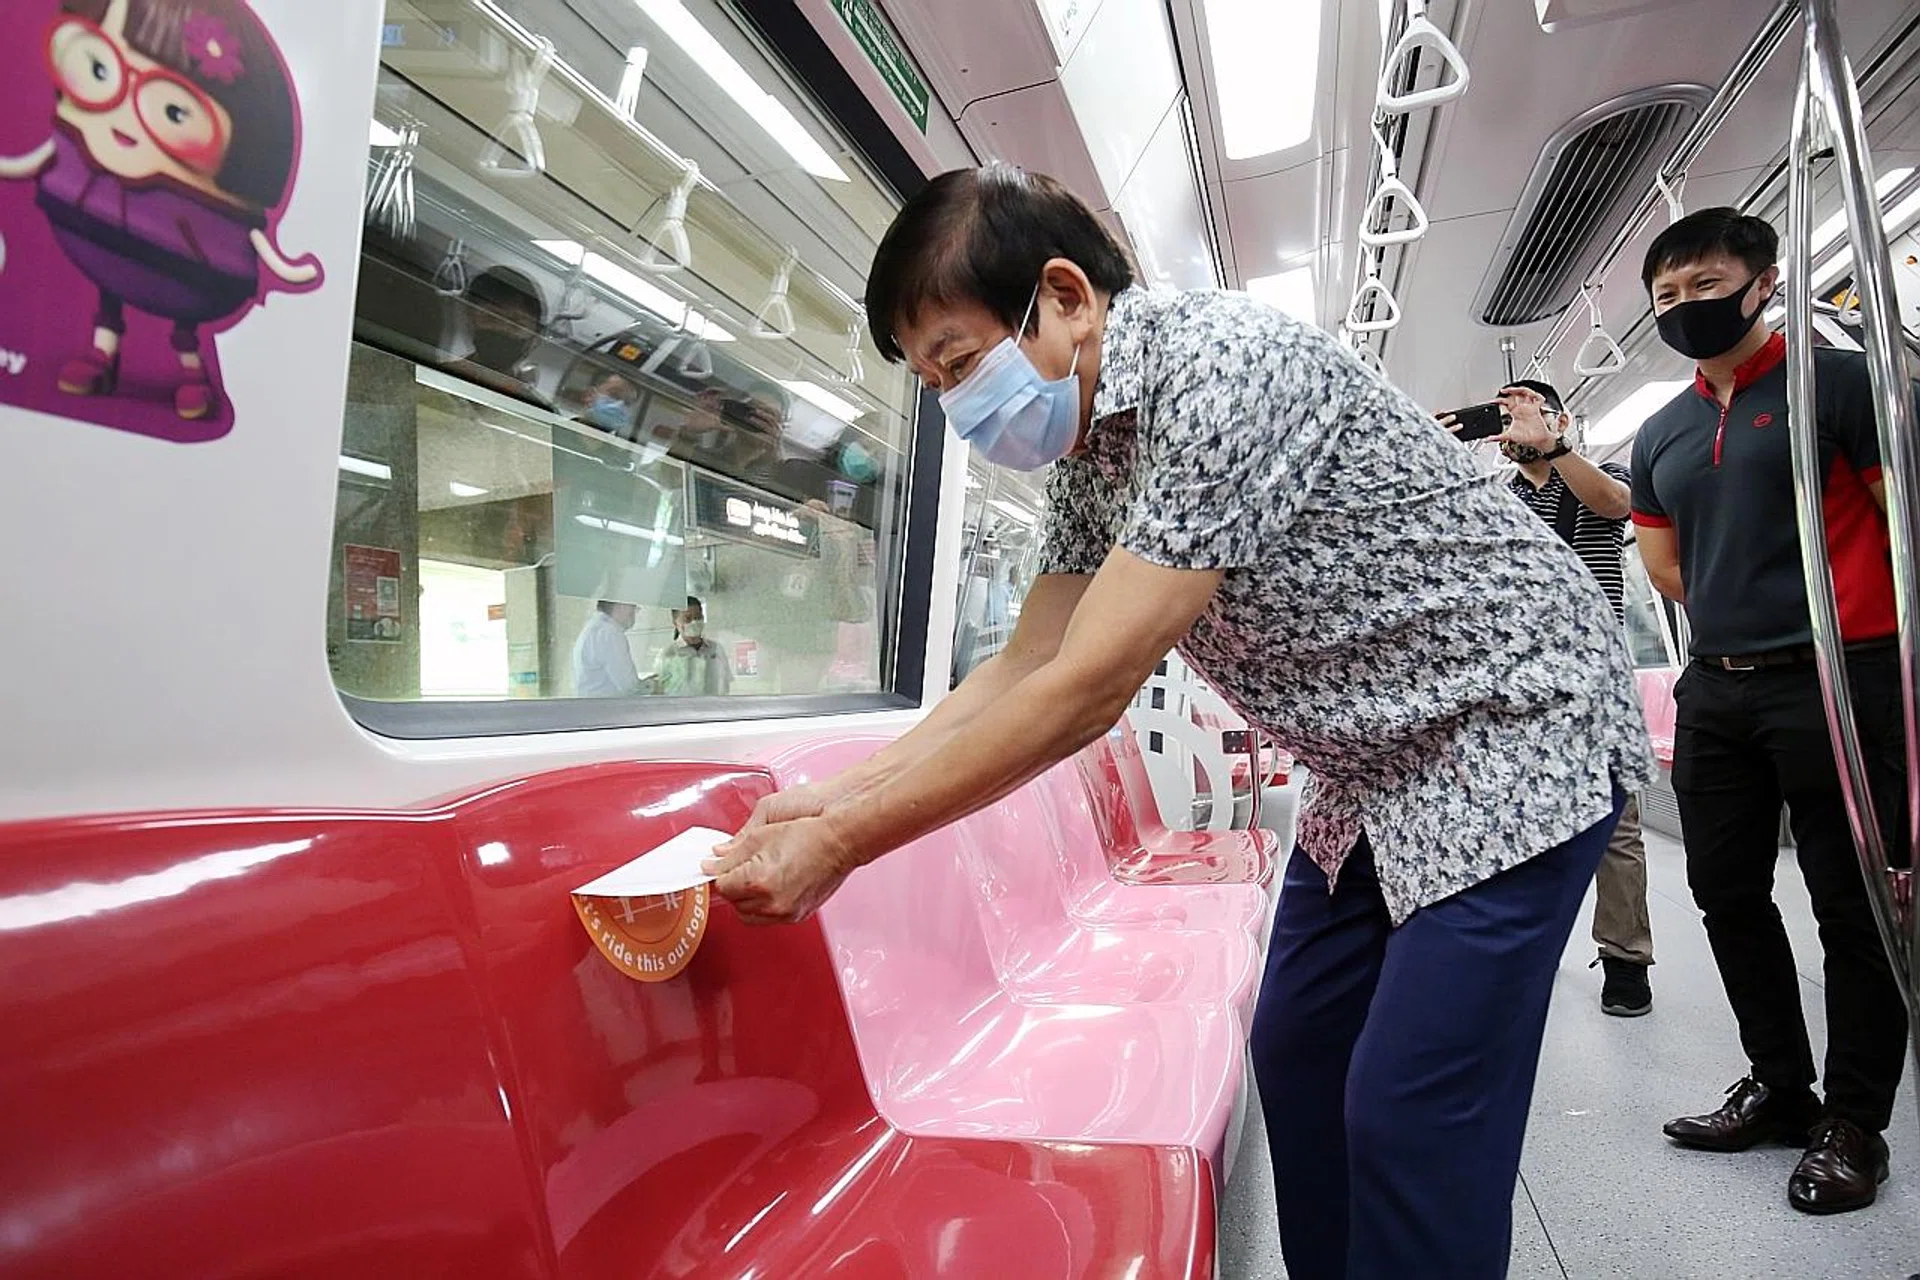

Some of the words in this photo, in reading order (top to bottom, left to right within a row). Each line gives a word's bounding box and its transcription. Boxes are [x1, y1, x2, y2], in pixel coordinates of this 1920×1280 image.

[602, 931, 633, 966] ride
[637, 954, 665, 972] this
[668, 937, 690, 965] out
